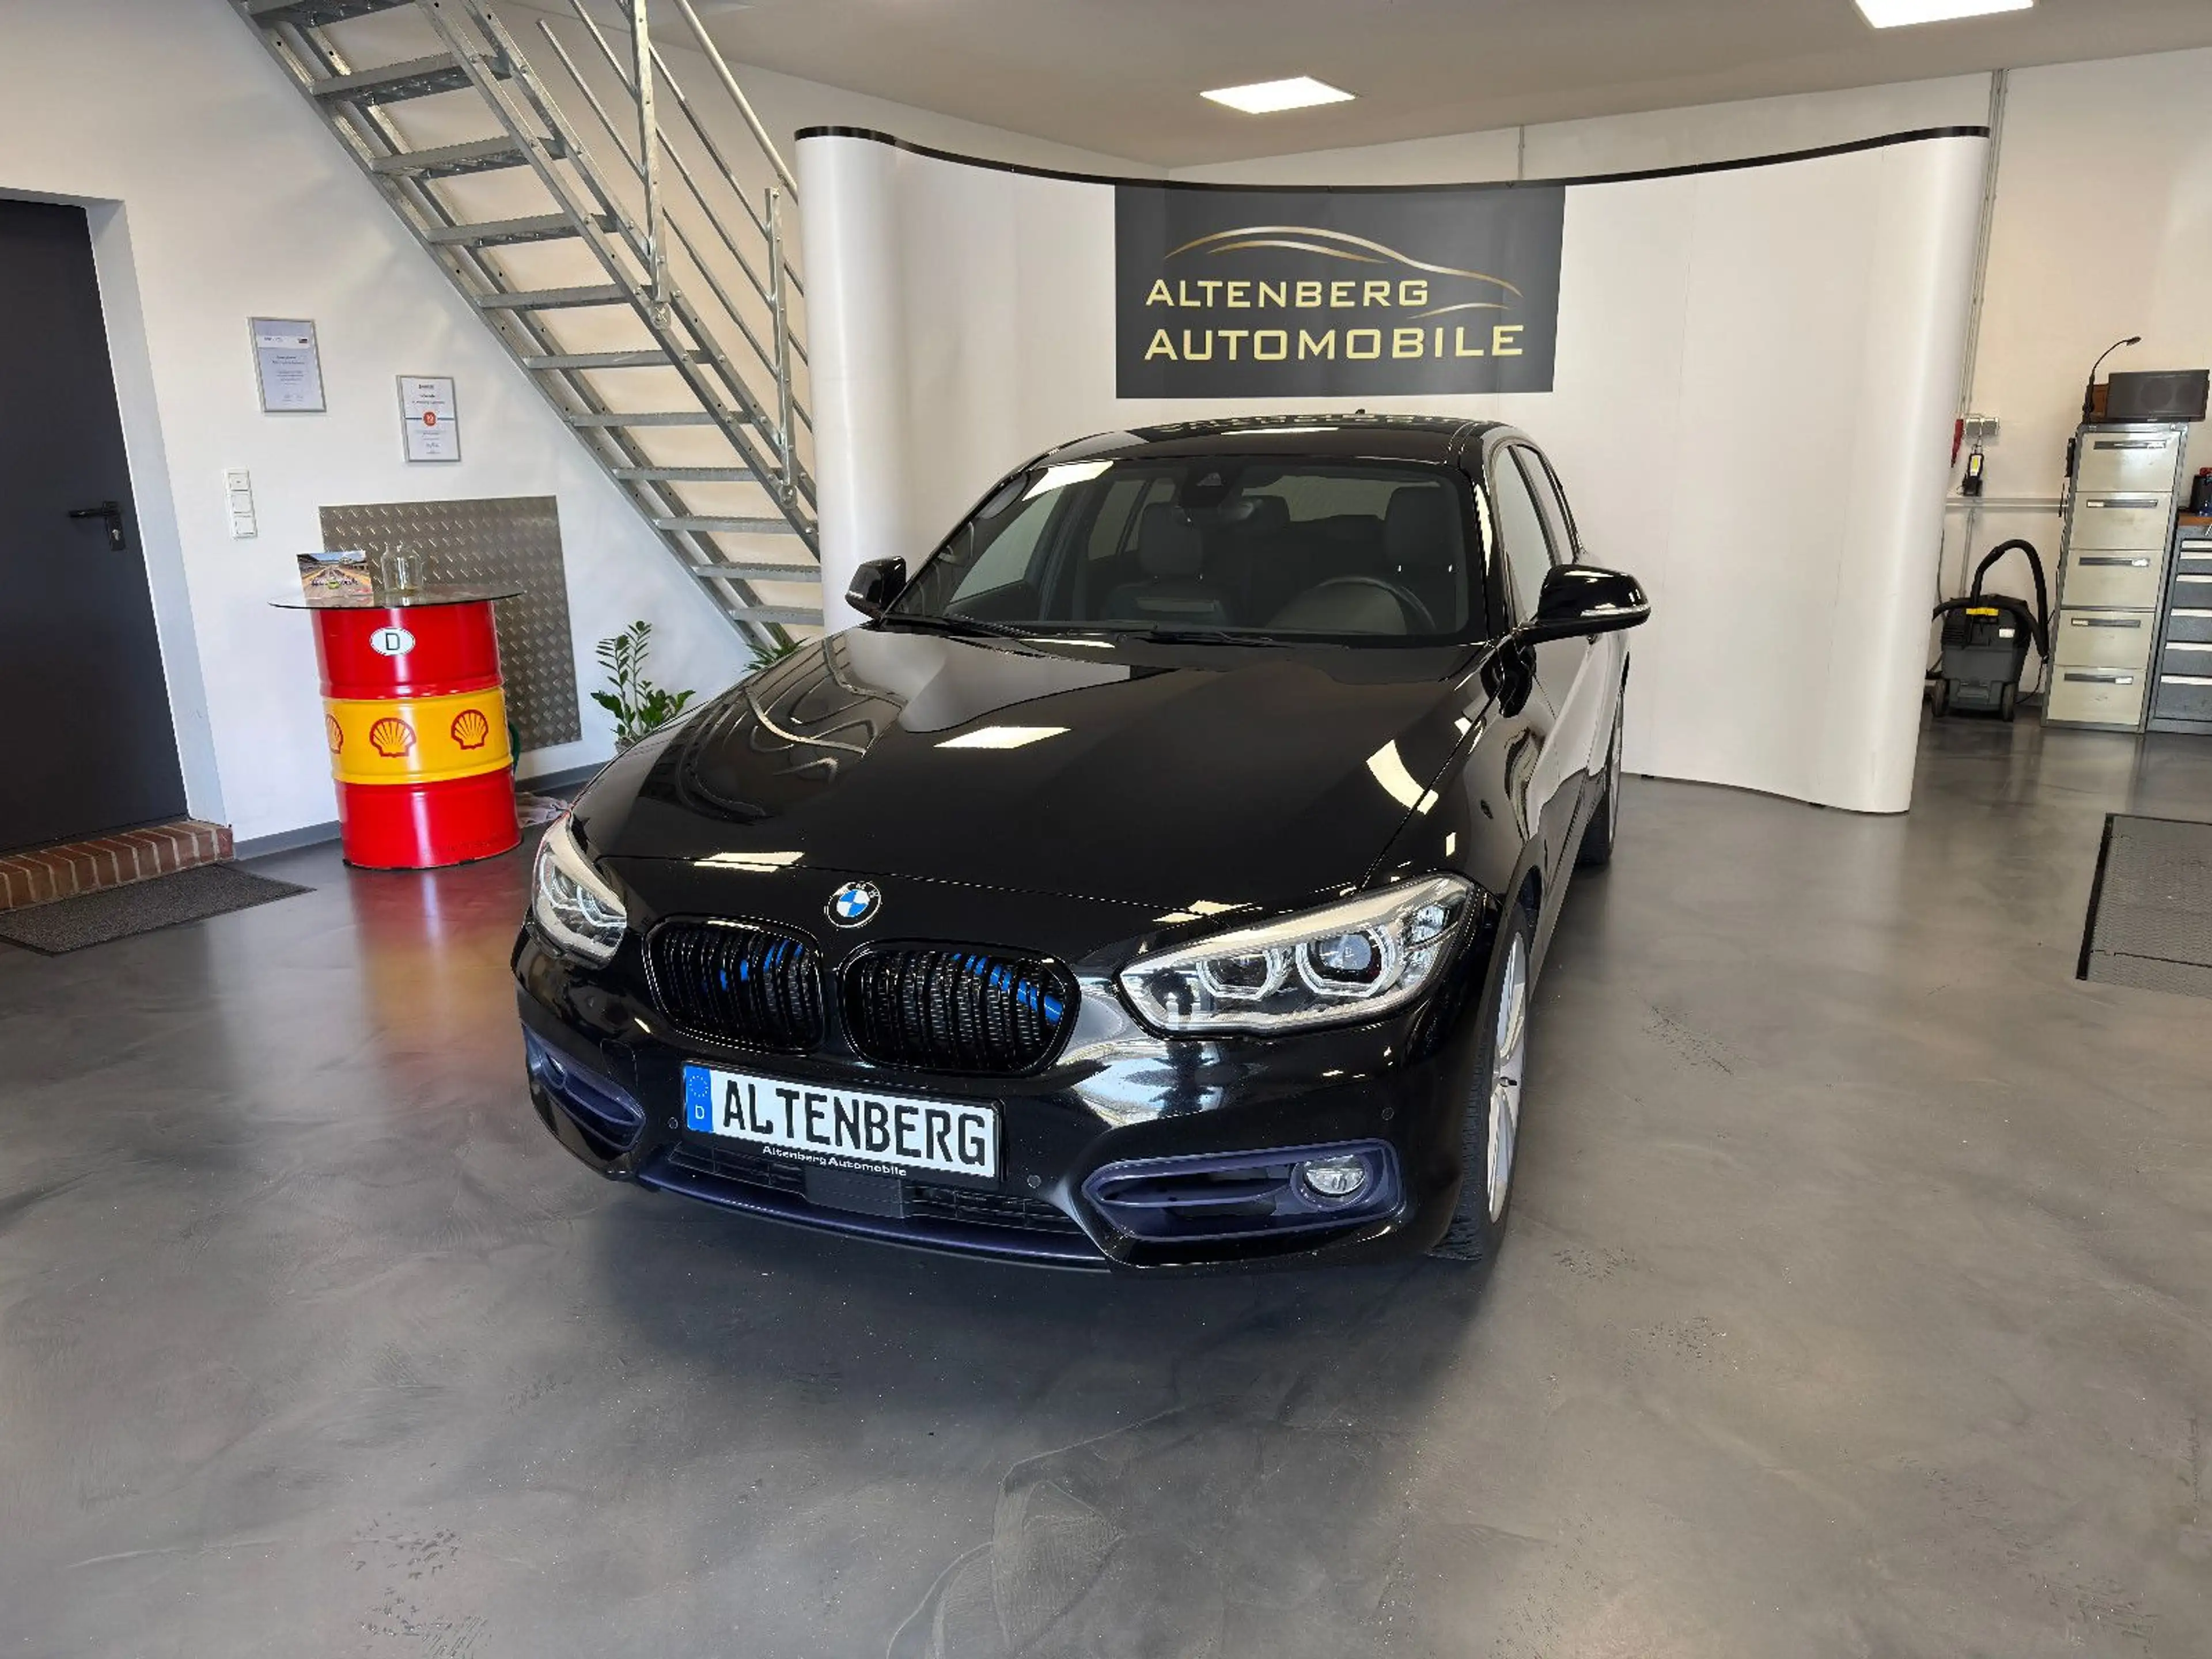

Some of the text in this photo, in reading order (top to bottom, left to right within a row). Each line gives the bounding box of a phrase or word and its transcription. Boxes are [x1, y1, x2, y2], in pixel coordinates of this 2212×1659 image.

[1145, 279, 1429, 308] ALTENBERG
[1144, 325, 1524, 361] AUTOMOBILE
[385, 633, 400, 650] D
[695, 1104, 706, 1119] D
[724, 1080, 986, 1166] ALTENBERG
[763, 1146, 907, 1176] Altenberg Automobile
